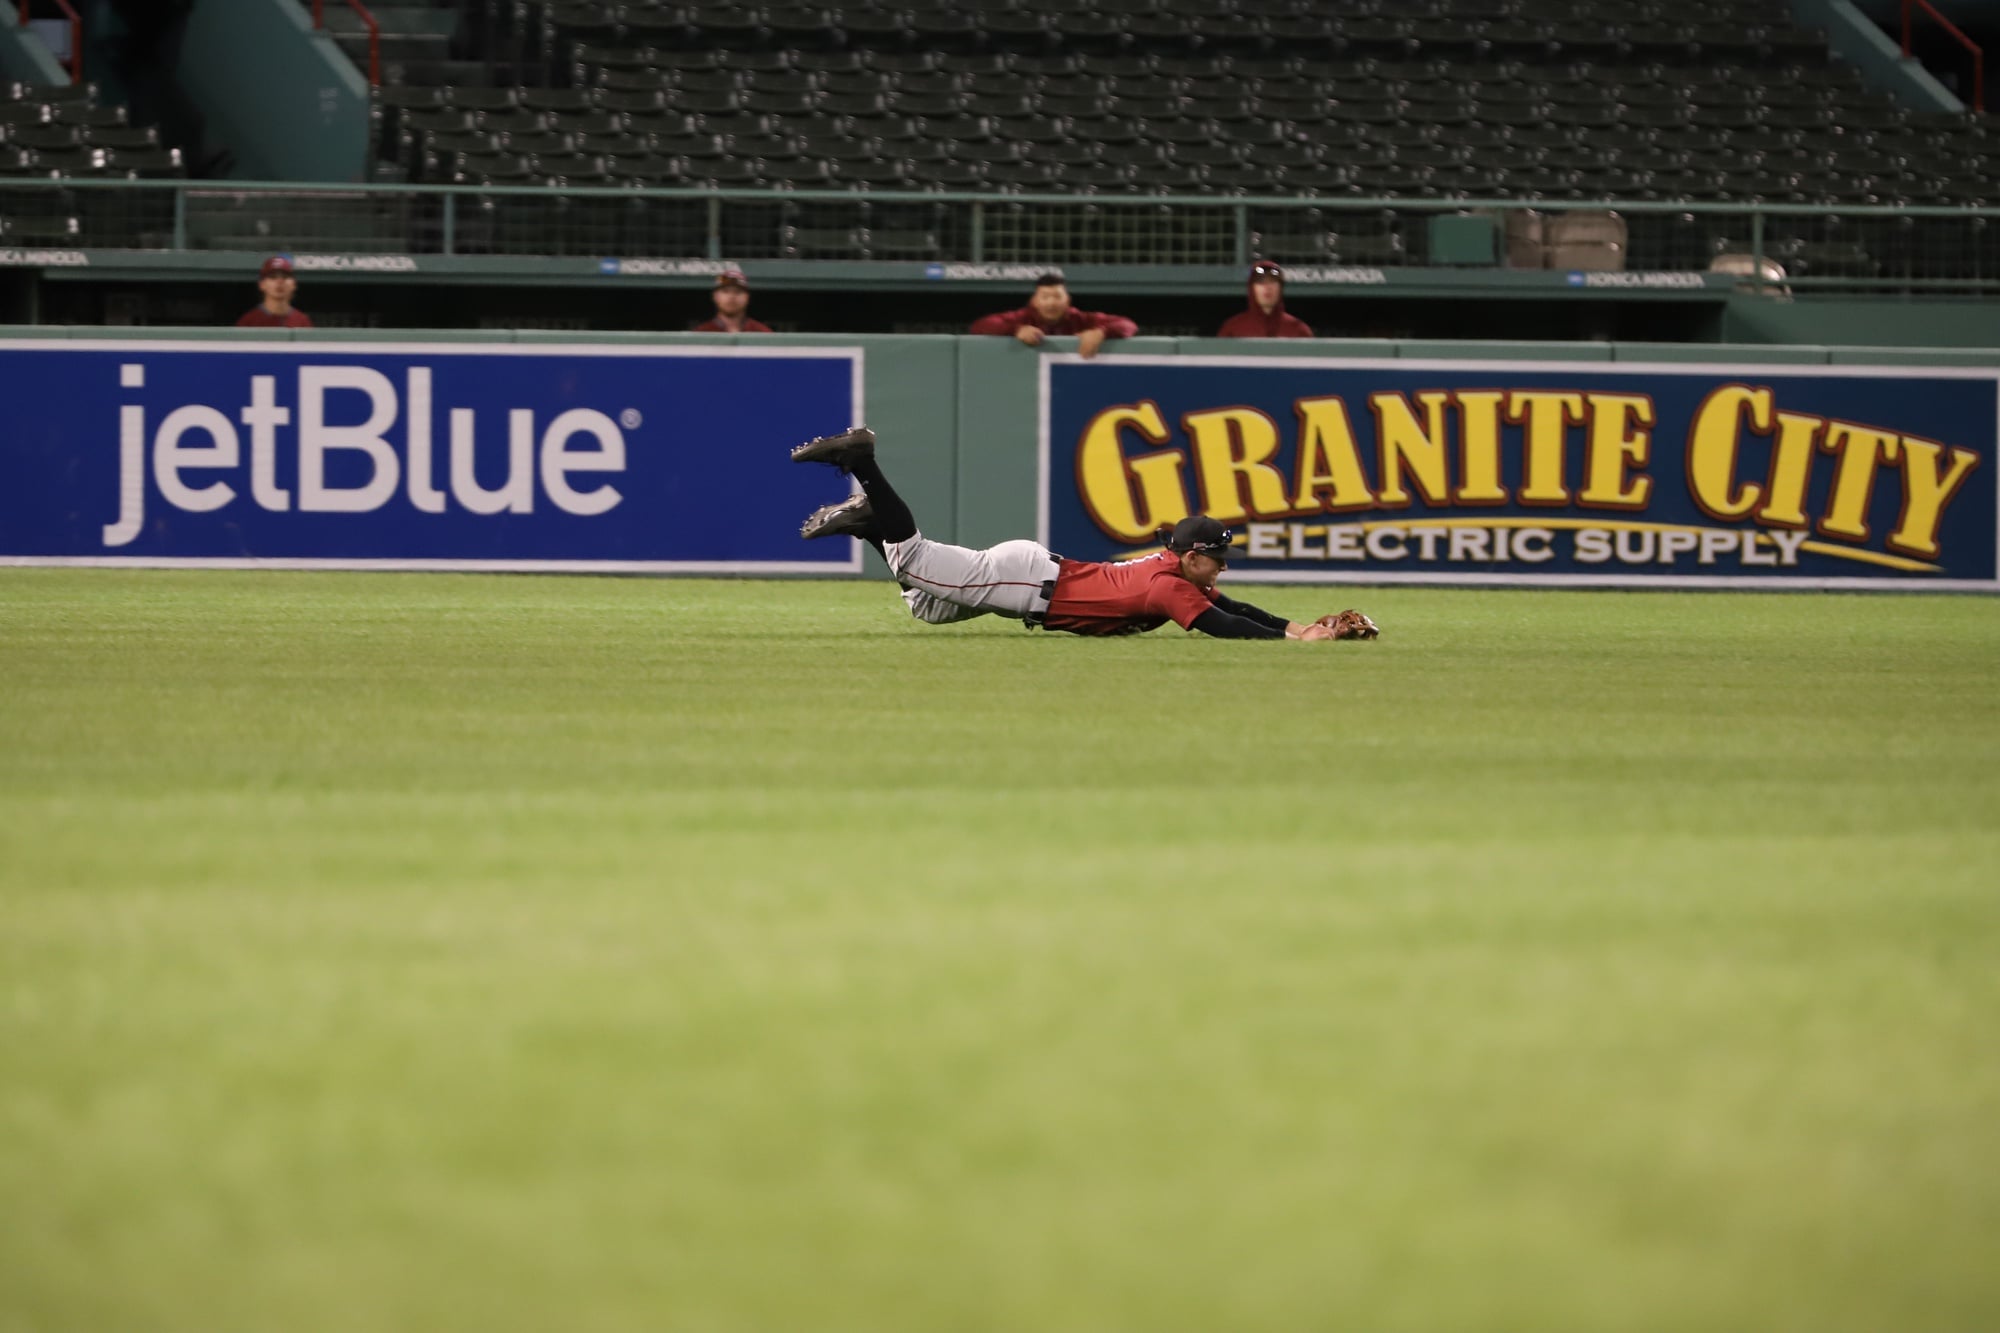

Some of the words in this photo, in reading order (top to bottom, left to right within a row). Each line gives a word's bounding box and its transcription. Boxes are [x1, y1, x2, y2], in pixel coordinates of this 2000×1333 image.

[293, 255, 350, 270] KONICA
[353, 256, 417, 272] MINOLTA
[620, 258, 675, 274] KONICA
[944, 264, 999, 280] KONICA
[1586, 273, 1641, 287] KONICA
[1643, 273, 1706, 288] MINOLTA
[103, 364, 626, 546] jetBlue
[1076, 389, 1656, 543] GRANITE
[1686, 382, 1980, 559] CITY
[1247, 523, 1554, 562] ELECTRIC
[1575, 528, 1809, 567] SUPPLY
